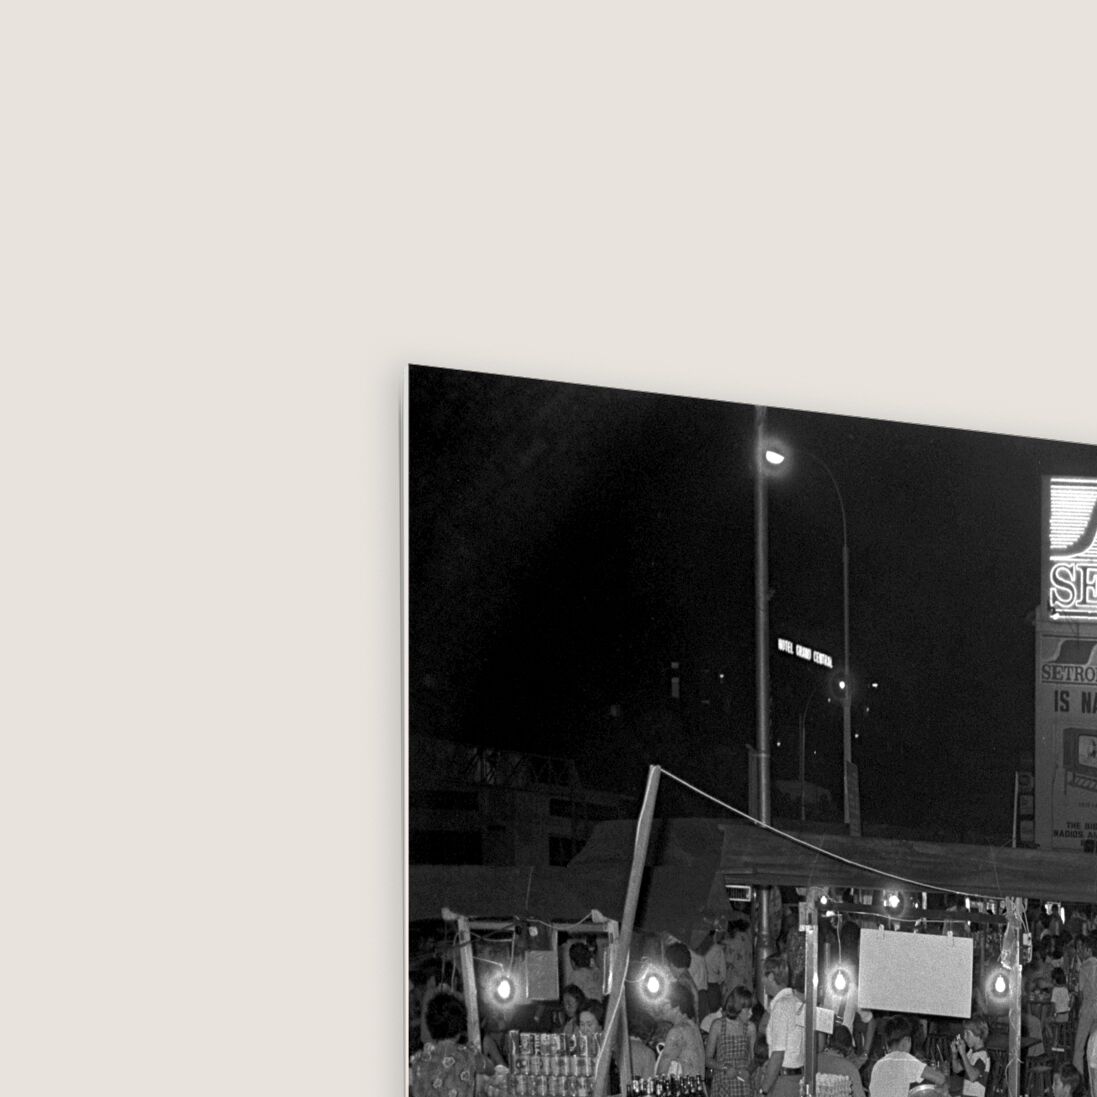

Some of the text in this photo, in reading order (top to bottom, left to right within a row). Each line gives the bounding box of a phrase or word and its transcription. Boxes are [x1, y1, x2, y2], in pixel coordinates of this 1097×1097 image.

[1054, 690, 1070, 713] IS
[1066, 821, 1081, 830] THE
[1084, 822, 1097, 831] BIG
[1053, 829, 1083, 839] RADIOS
